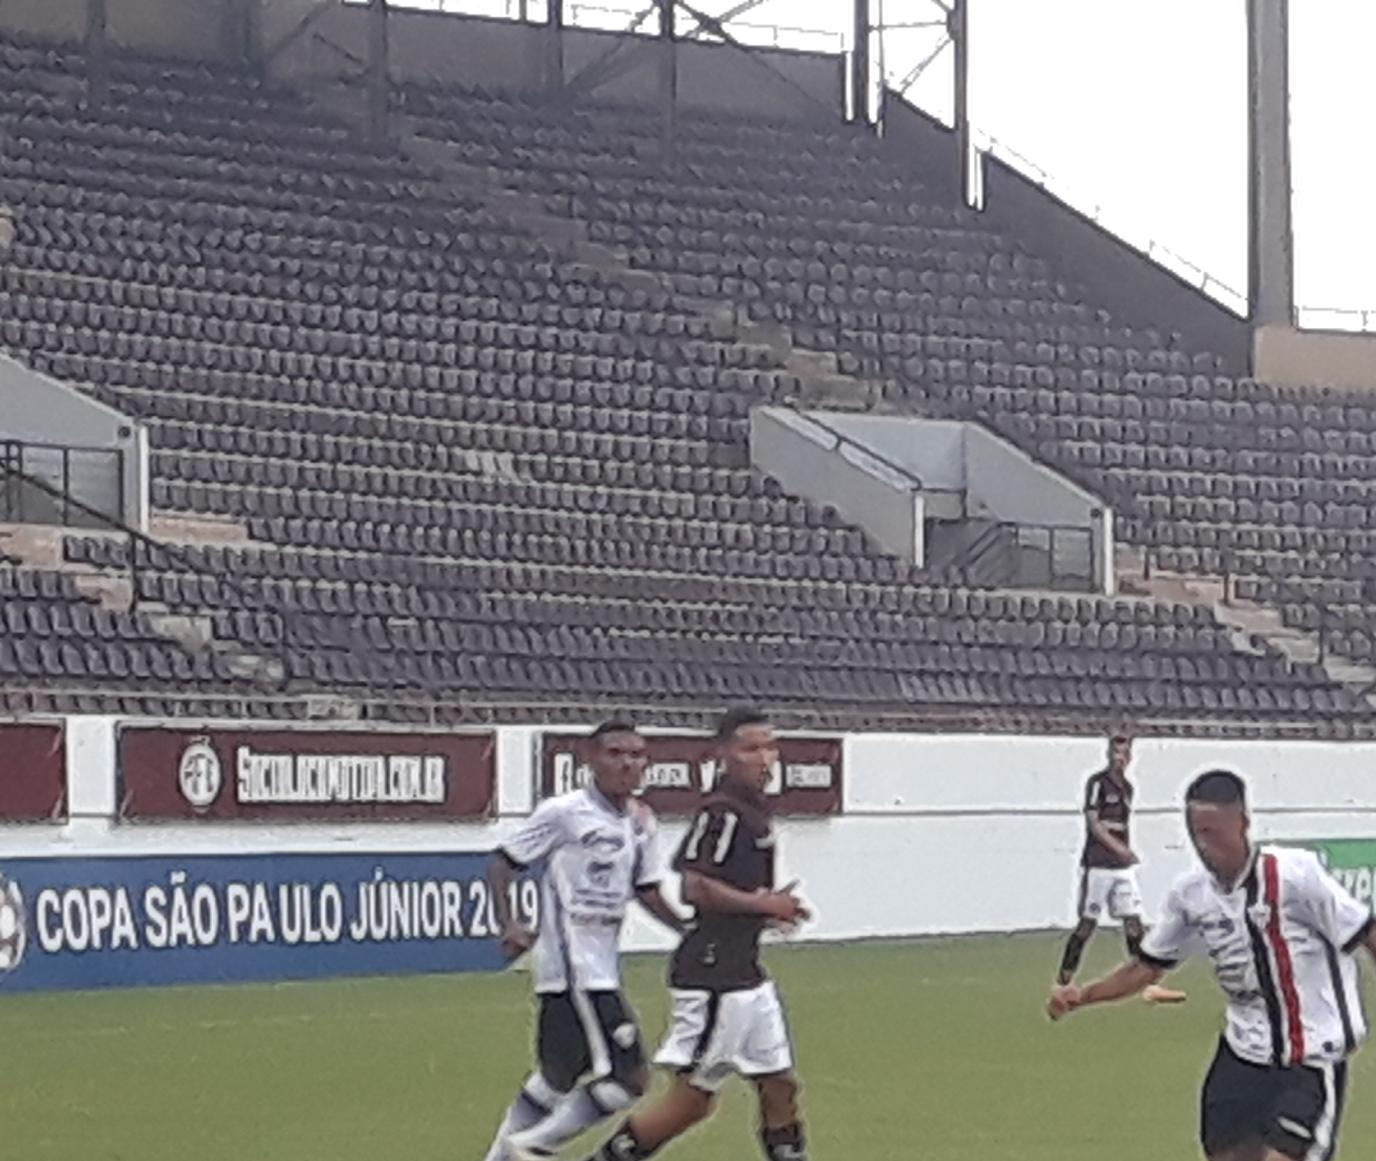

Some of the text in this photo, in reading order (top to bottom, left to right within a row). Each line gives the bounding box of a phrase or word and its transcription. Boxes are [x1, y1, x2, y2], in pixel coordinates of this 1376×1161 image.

[37, 887, 138, 952] COPA
[145, 871, 219, 947] SÃO
[227, 883, 342, 943] PAULO
[351, 866, 463, 941] JÚNIOR
